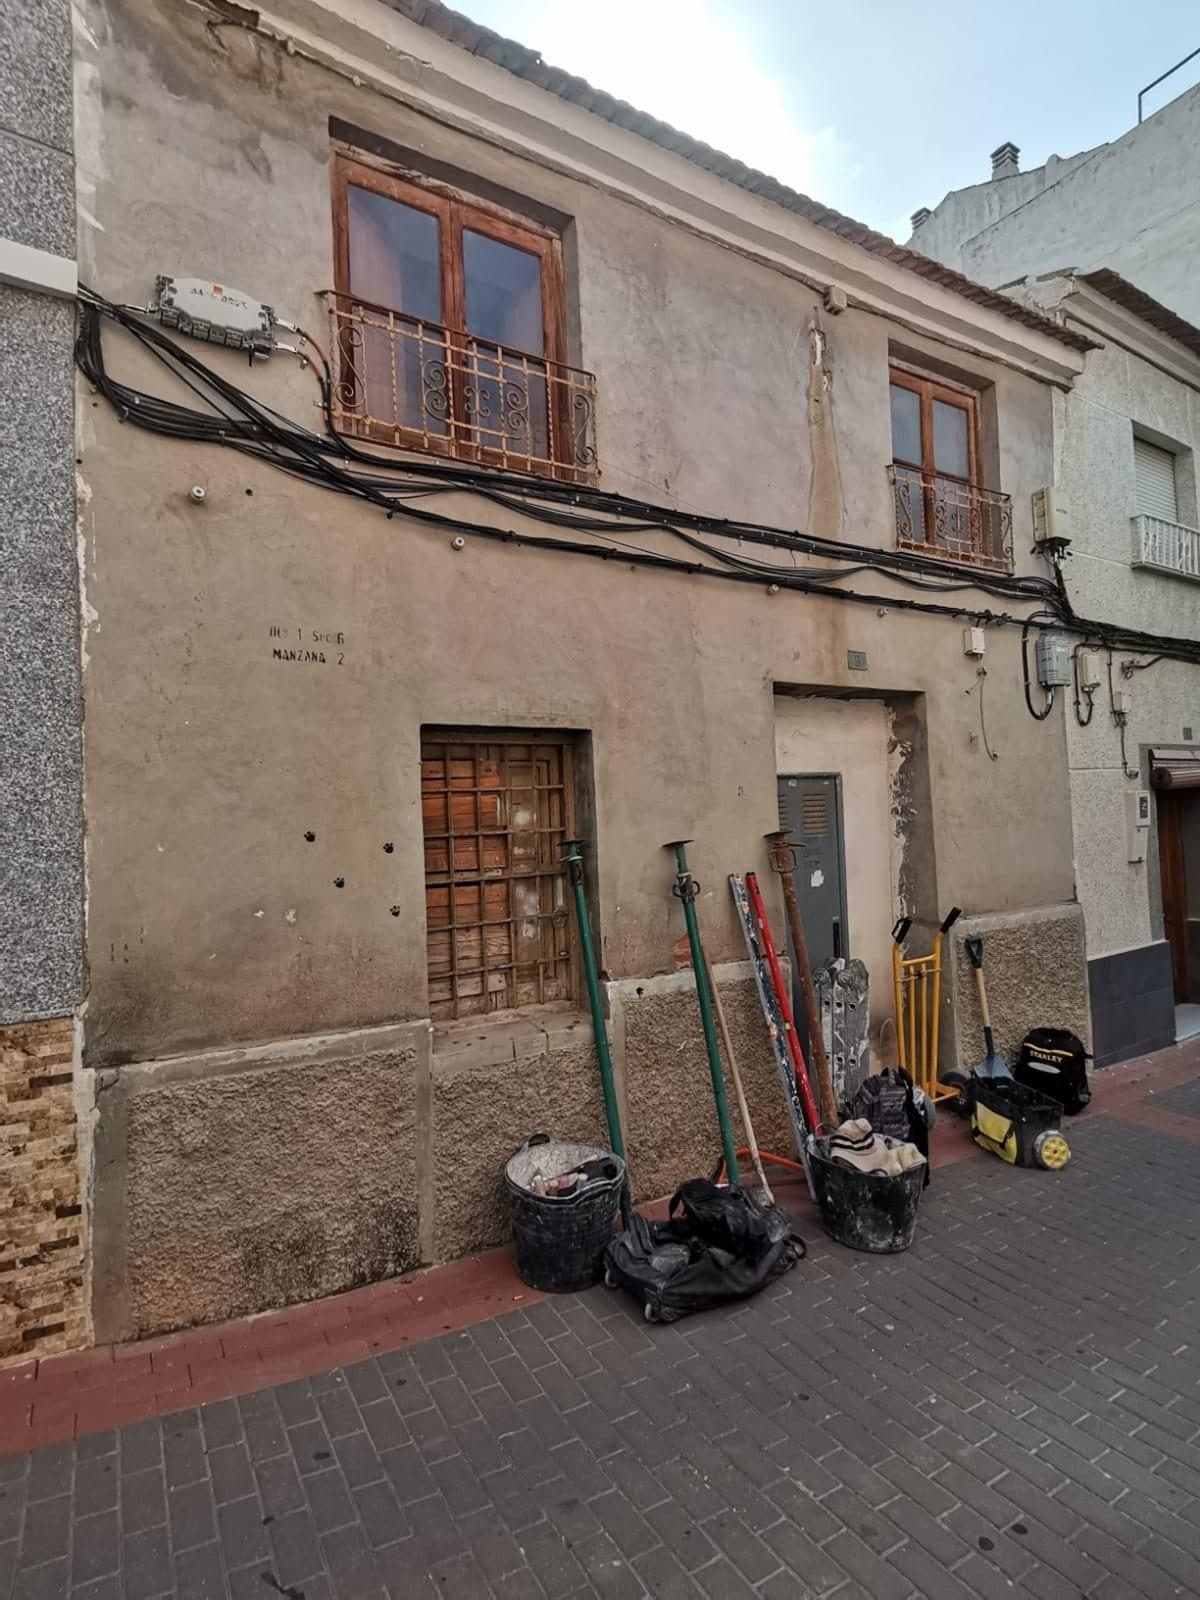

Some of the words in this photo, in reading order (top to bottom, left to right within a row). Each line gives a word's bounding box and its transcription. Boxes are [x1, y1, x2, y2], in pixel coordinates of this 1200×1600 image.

[272, 648, 326, 664] MANZANA
[337, 652, 345, 666] 2
[1029, 1050, 1064, 1064] STANLEY
